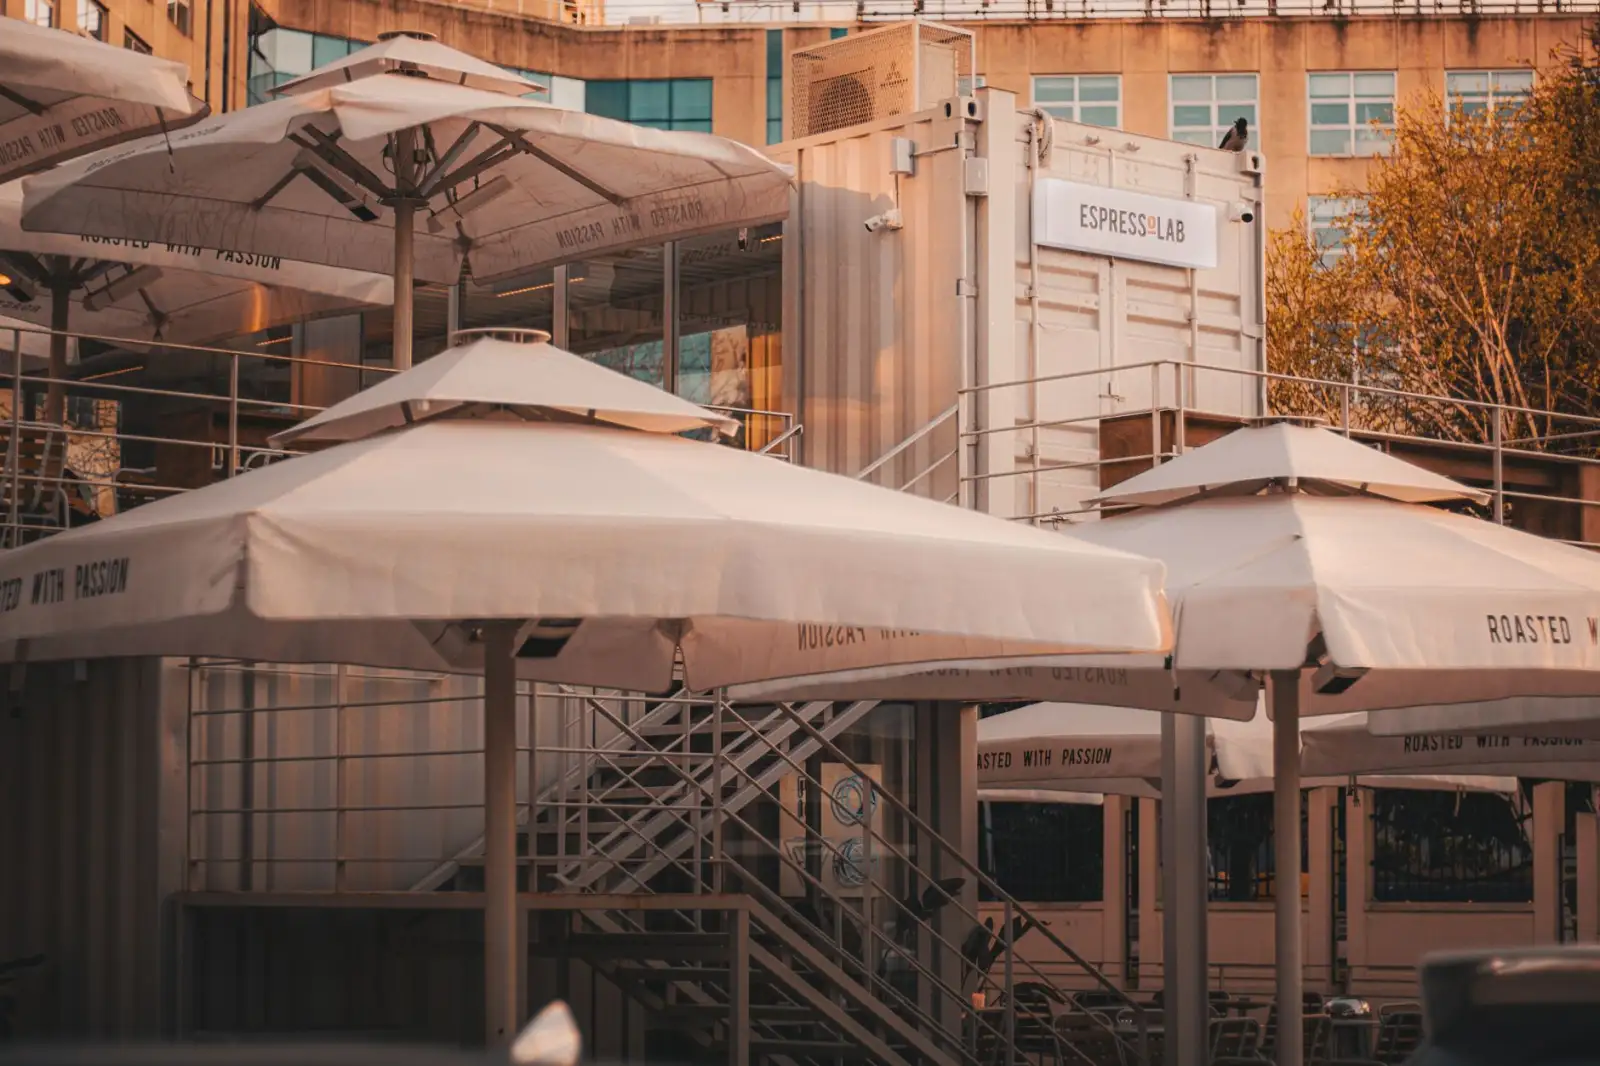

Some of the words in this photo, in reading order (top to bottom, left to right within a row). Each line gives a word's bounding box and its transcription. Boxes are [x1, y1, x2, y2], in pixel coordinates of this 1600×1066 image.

[1080, 203, 1186, 243] ESPRESSOLAB
[0, 577, 22, 613] TED
[31, 568, 65, 605] WITH
[76, 557, 129, 600] PASSION
[1487, 614, 1571, 643] ROASTED
[1023, 749, 1052, 767] WITH
[1062, 747, 1112, 767] PASSION
